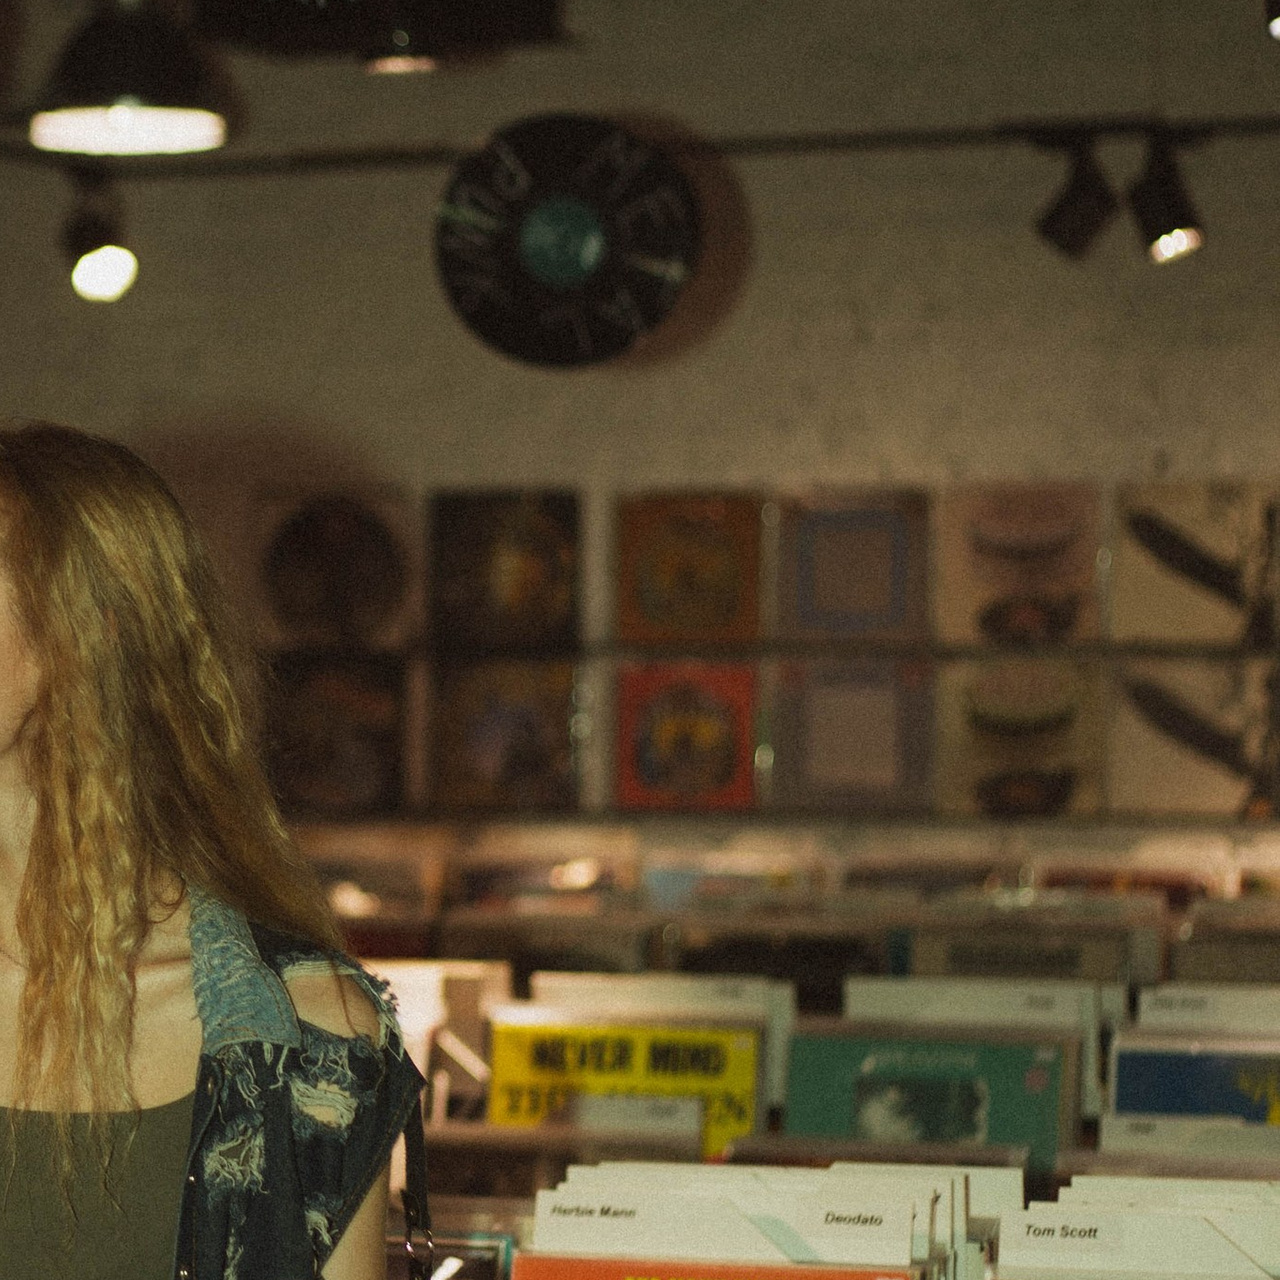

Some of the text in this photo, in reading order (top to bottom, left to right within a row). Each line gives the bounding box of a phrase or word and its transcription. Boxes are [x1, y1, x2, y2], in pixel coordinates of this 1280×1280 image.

[551, 1205, 637, 1219] Herbie Mann
[824, 1211, 883, 1227] Deodato
[1025, 1223, 1098, 1239] Tom Scott
